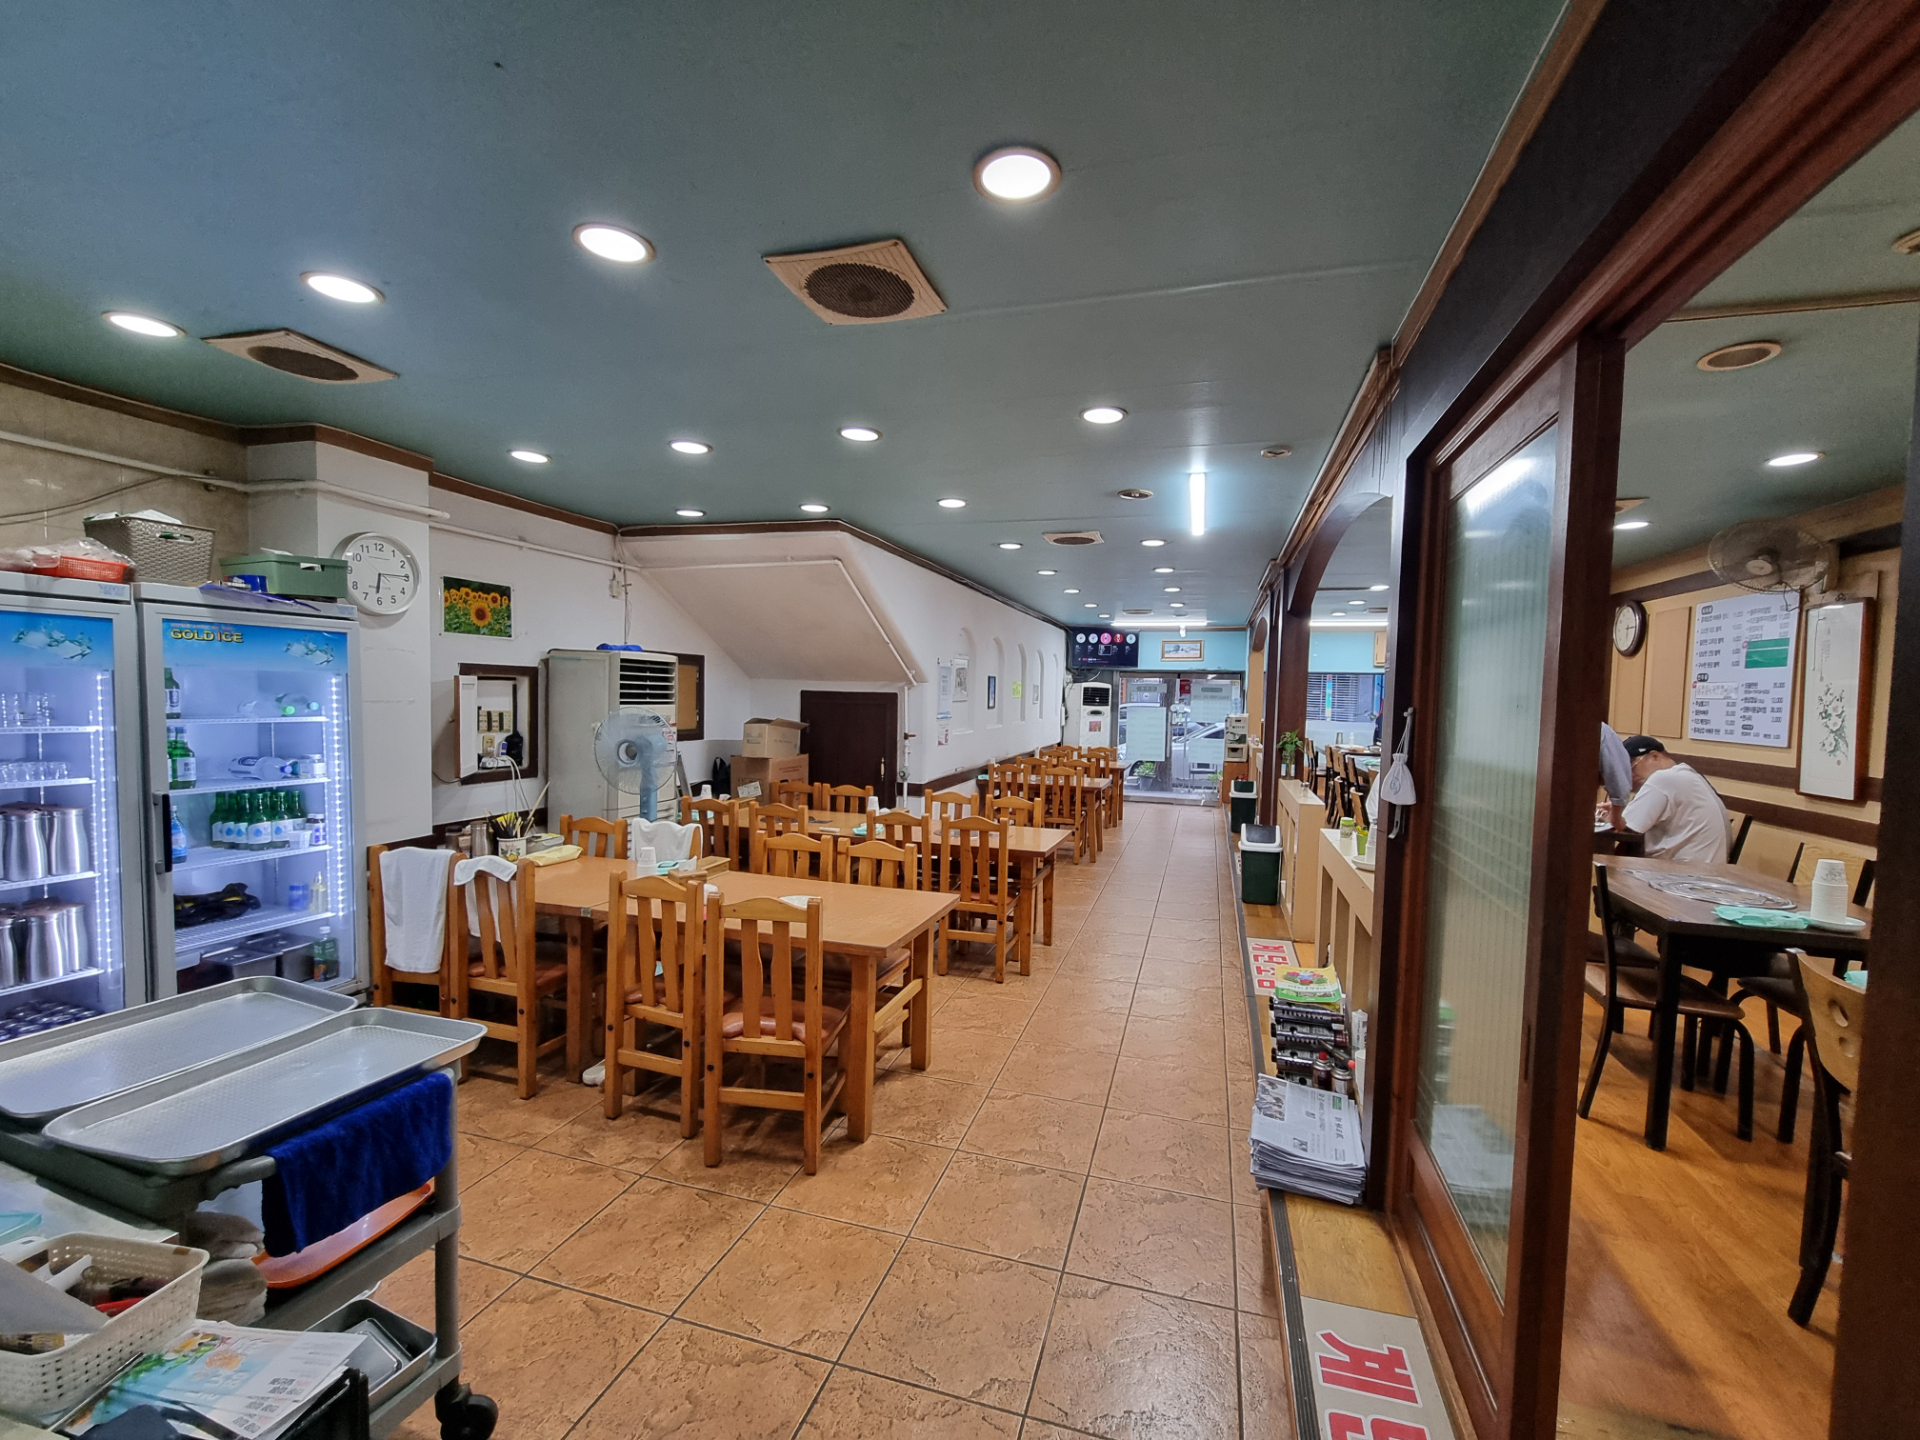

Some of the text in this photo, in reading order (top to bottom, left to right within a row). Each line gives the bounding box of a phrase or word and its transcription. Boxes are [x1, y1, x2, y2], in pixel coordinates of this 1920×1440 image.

[360, 544, 370, 553] 11
[374, 543, 384, 552] 12
[352, 552, 362, 562] 10
[391, 550, 396, 558] 1
[399, 560, 406, 569] 2
[347, 565, 353, 574] 9
[403, 573, 410, 582] 3
[352, 581, 358, 590] 8
[400, 587, 406, 595] 4
[362, 592, 369, 600] 7
[390, 595, 397, 604] 5
[376, 597, 383, 606] 6
[170, 628, 244, 643] GOLD ICE
